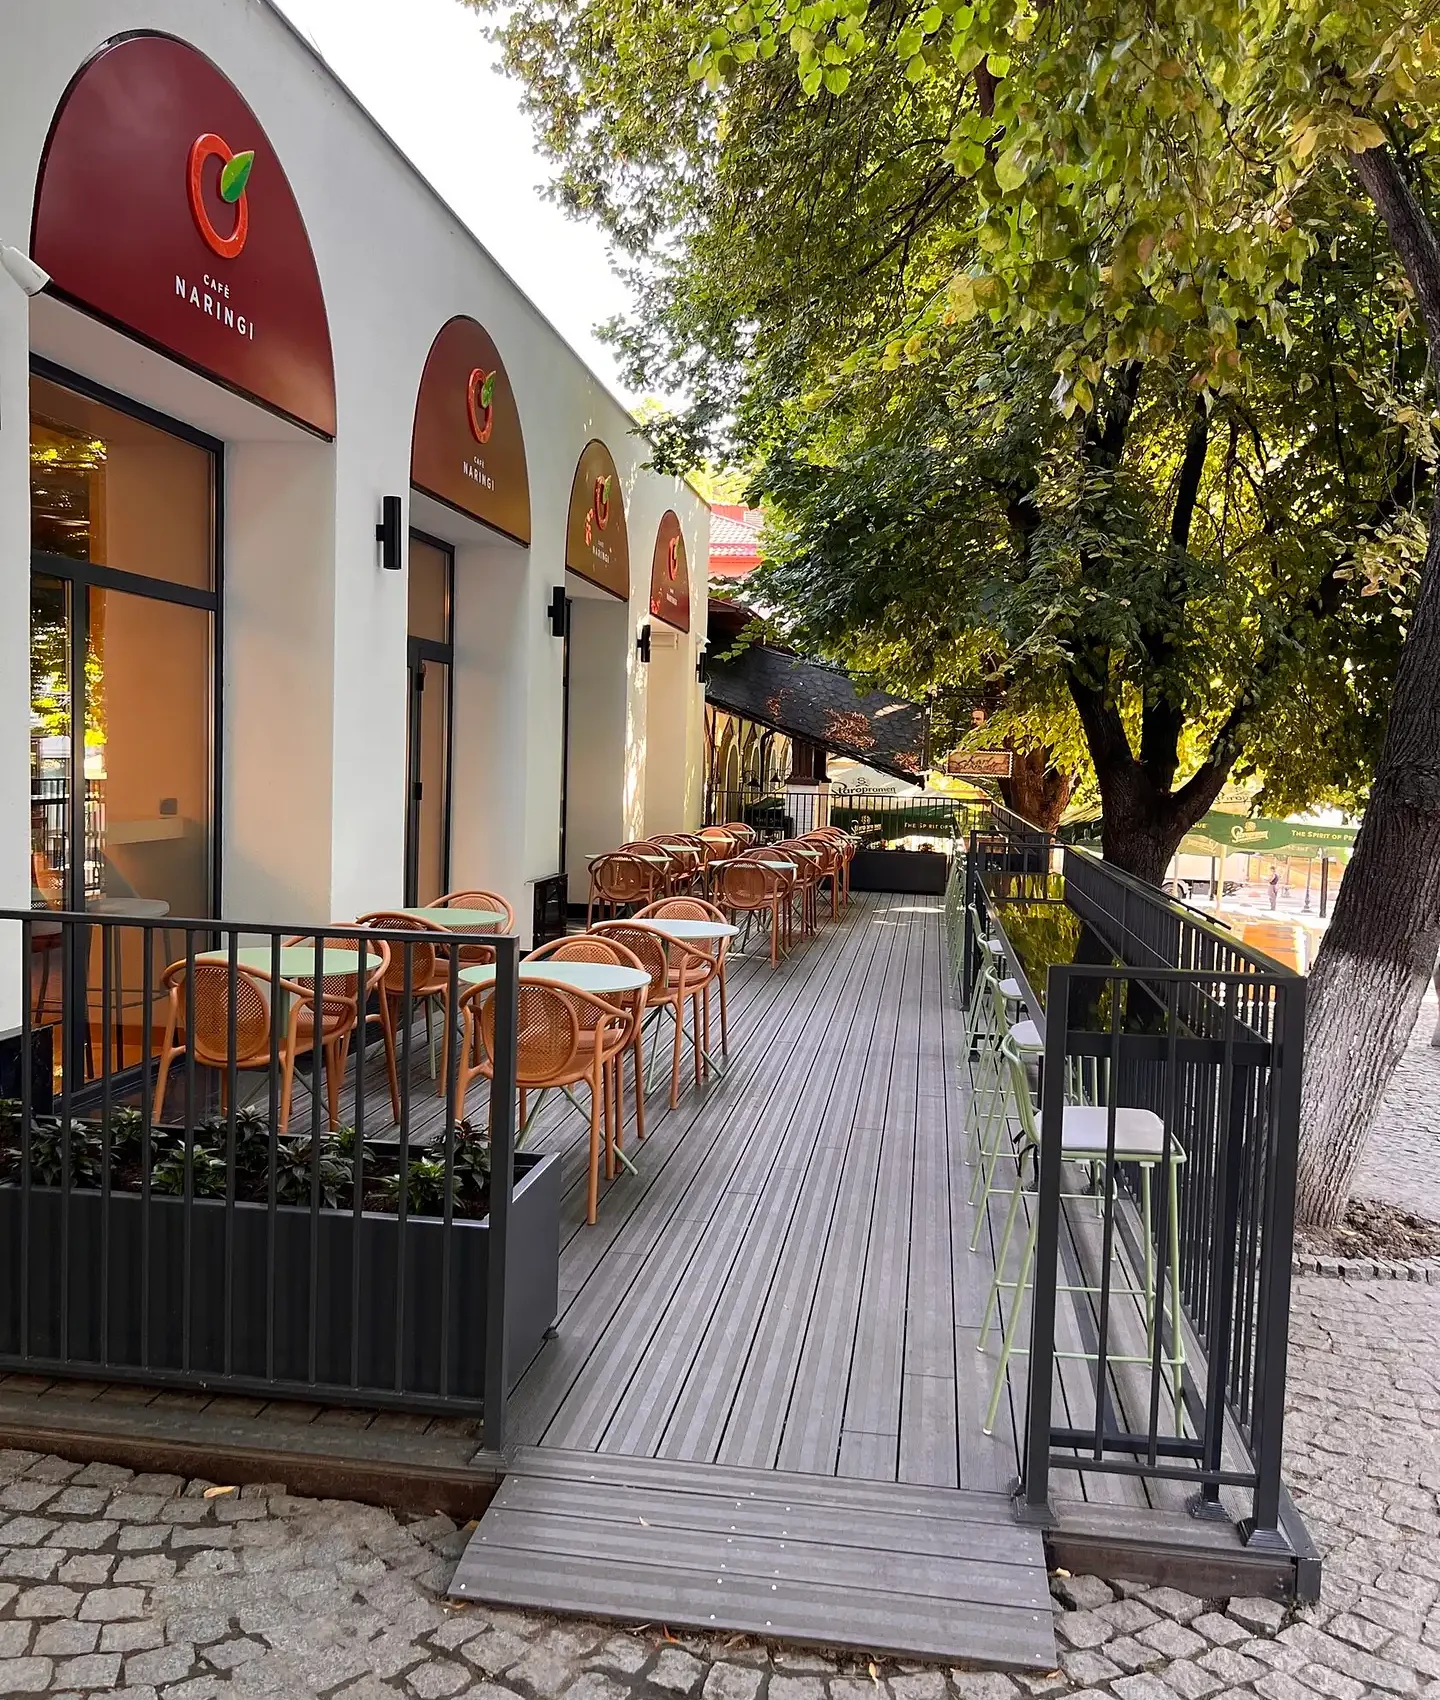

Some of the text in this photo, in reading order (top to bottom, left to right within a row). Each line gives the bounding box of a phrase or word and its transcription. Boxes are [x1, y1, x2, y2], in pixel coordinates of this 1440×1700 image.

[175, 274, 253, 340] NARINGI
[463, 460, 495, 491] NARINGI
[1291, 829, 1306, 837] THE
[1307, 831, 1330, 839] SPIRIT
